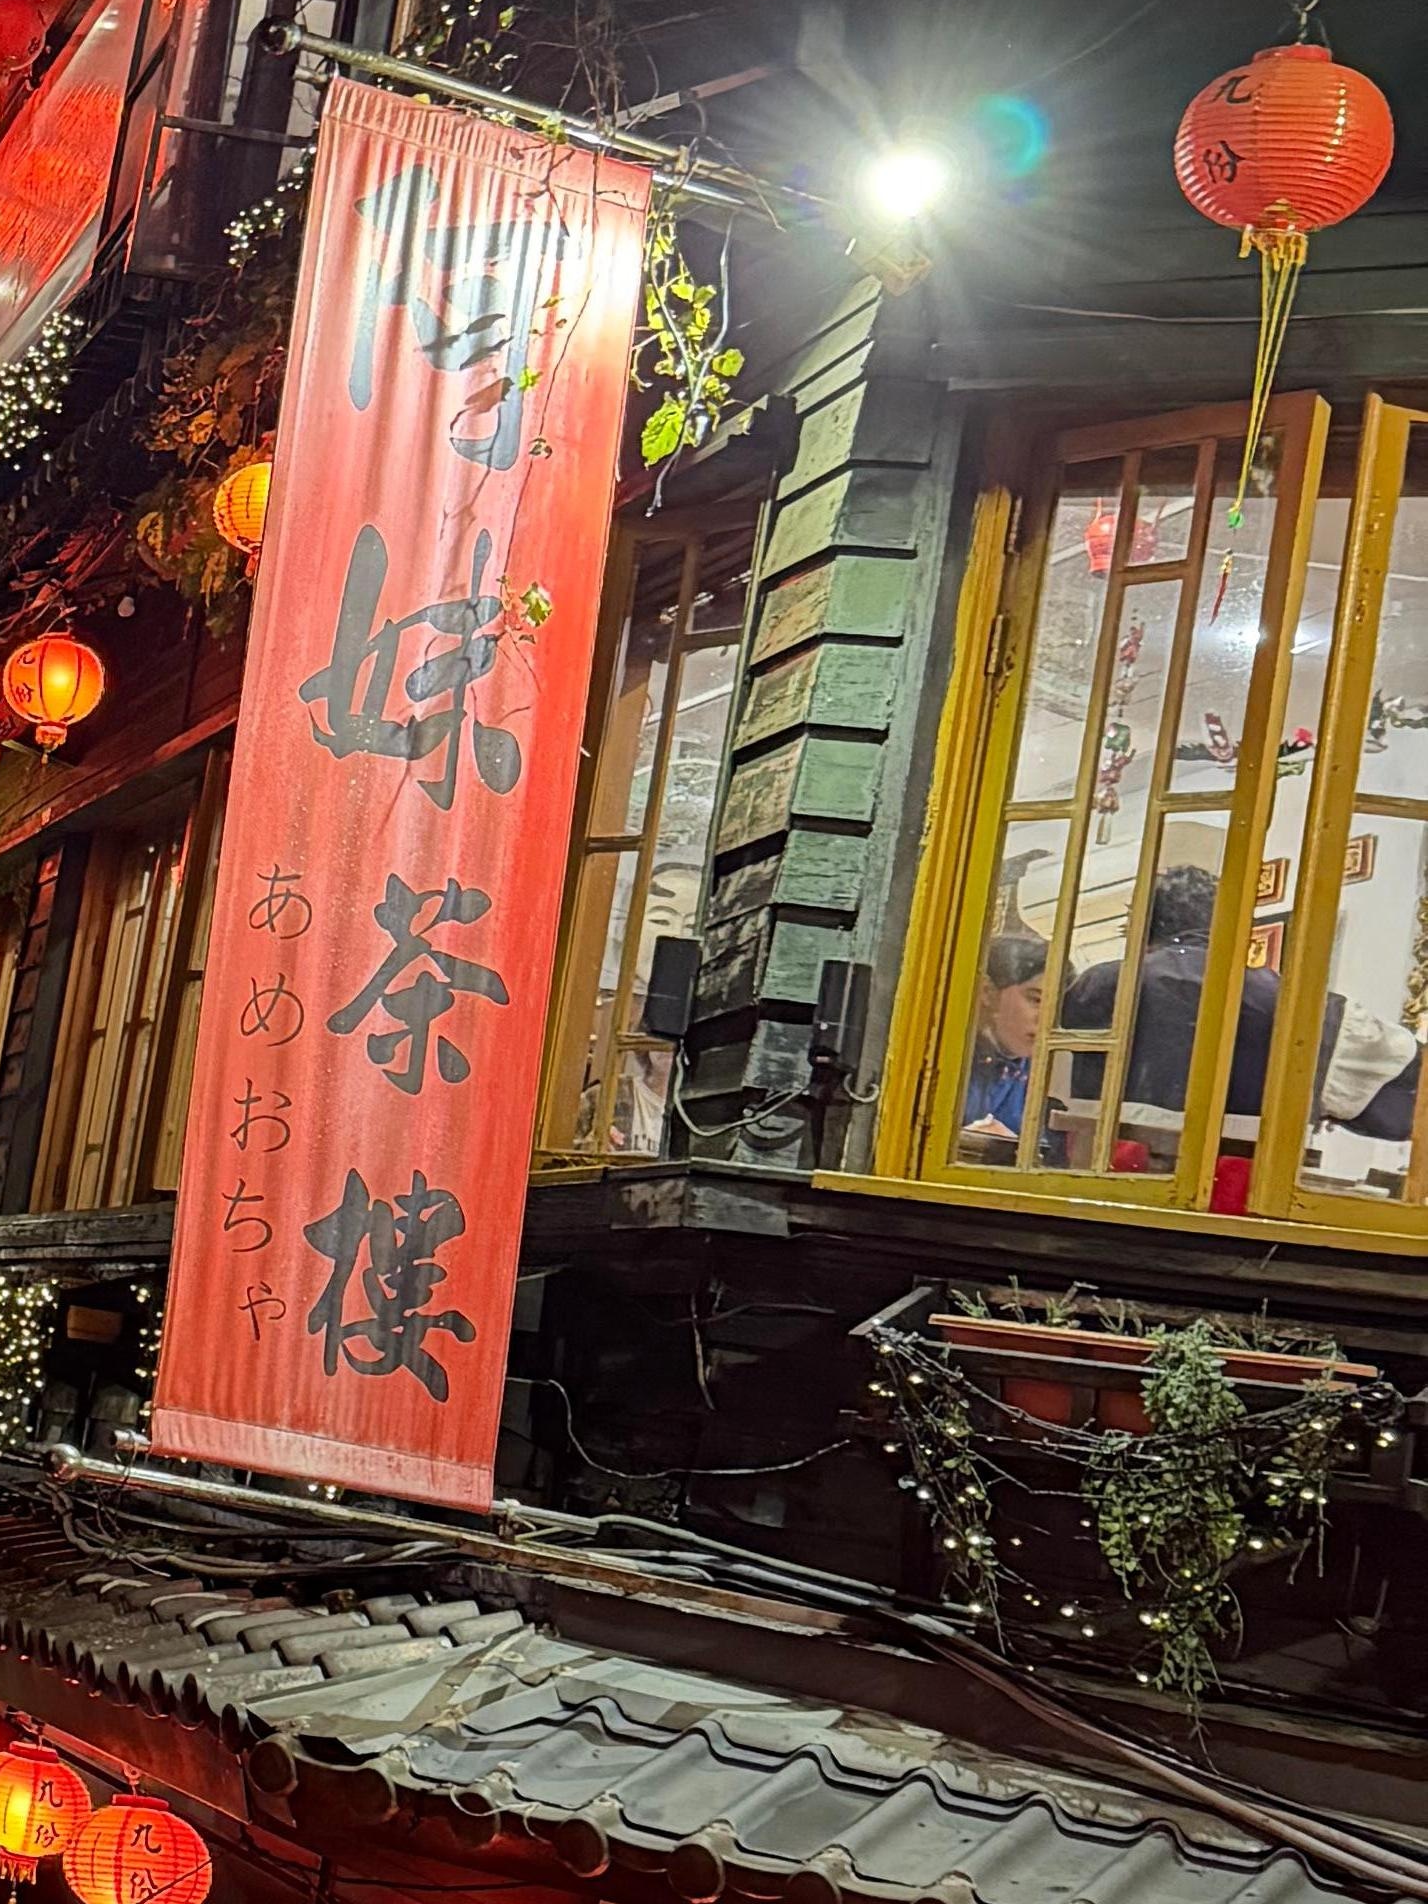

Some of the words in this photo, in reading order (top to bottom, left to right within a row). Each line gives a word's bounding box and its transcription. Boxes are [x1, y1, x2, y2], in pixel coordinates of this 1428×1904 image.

[1203, 74, 1260, 184] 九份
[298, 164, 576, 1404] 阿妹茶樓
[221, 863, 314, 1345] あめおちゃ
[34, 1780, 64, 1848] 九份
[129, 1823, 162, 1900] 九份
